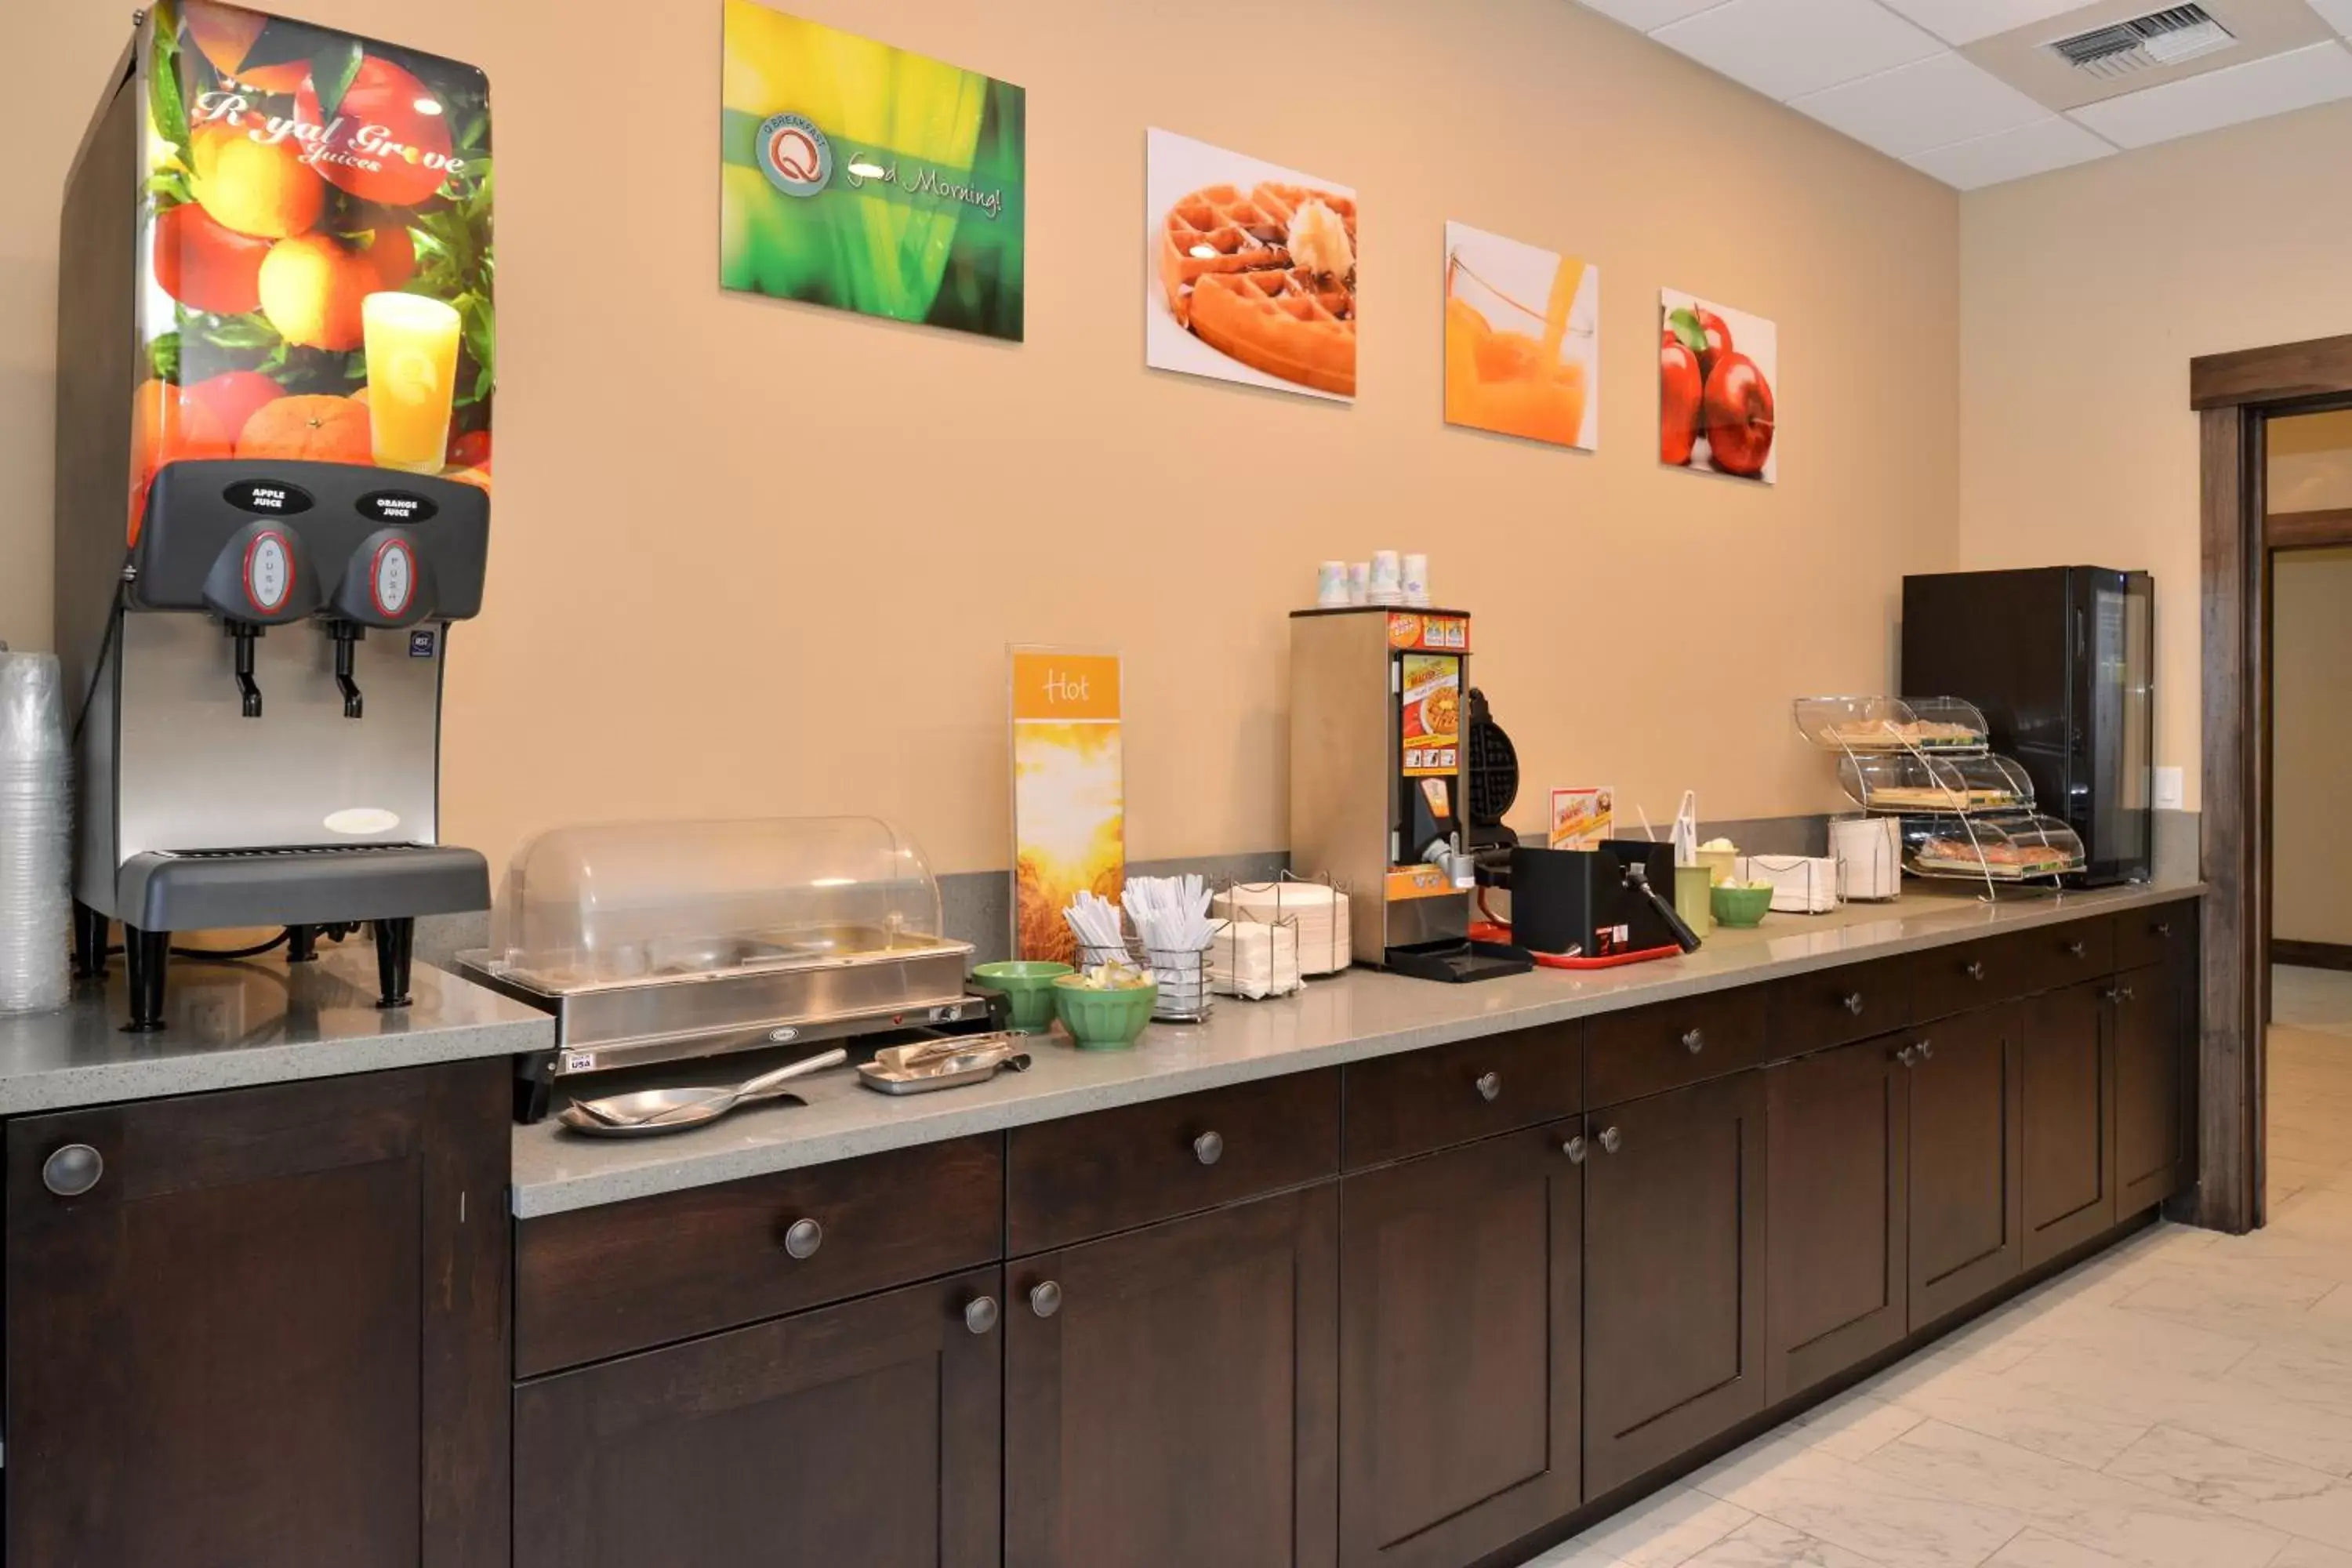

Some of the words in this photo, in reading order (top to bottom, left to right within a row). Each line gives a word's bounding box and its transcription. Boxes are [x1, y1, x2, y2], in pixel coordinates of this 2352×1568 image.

[771, 115, 826, 147] BREAKFAST
[771, 129, 824, 183] Q
[847, 151, 898, 187] Gd
[902, 166, 1002, 219] Morning!
[252, 488, 285, 499] APPLE
[253, 498, 282, 508] JUICE
[376, 499, 418, 509] ORANGE
[383, 507, 409, 517] JUICE
[1041, 667, 1090, 703] Hot
[572, 1060, 590, 1069] USA
